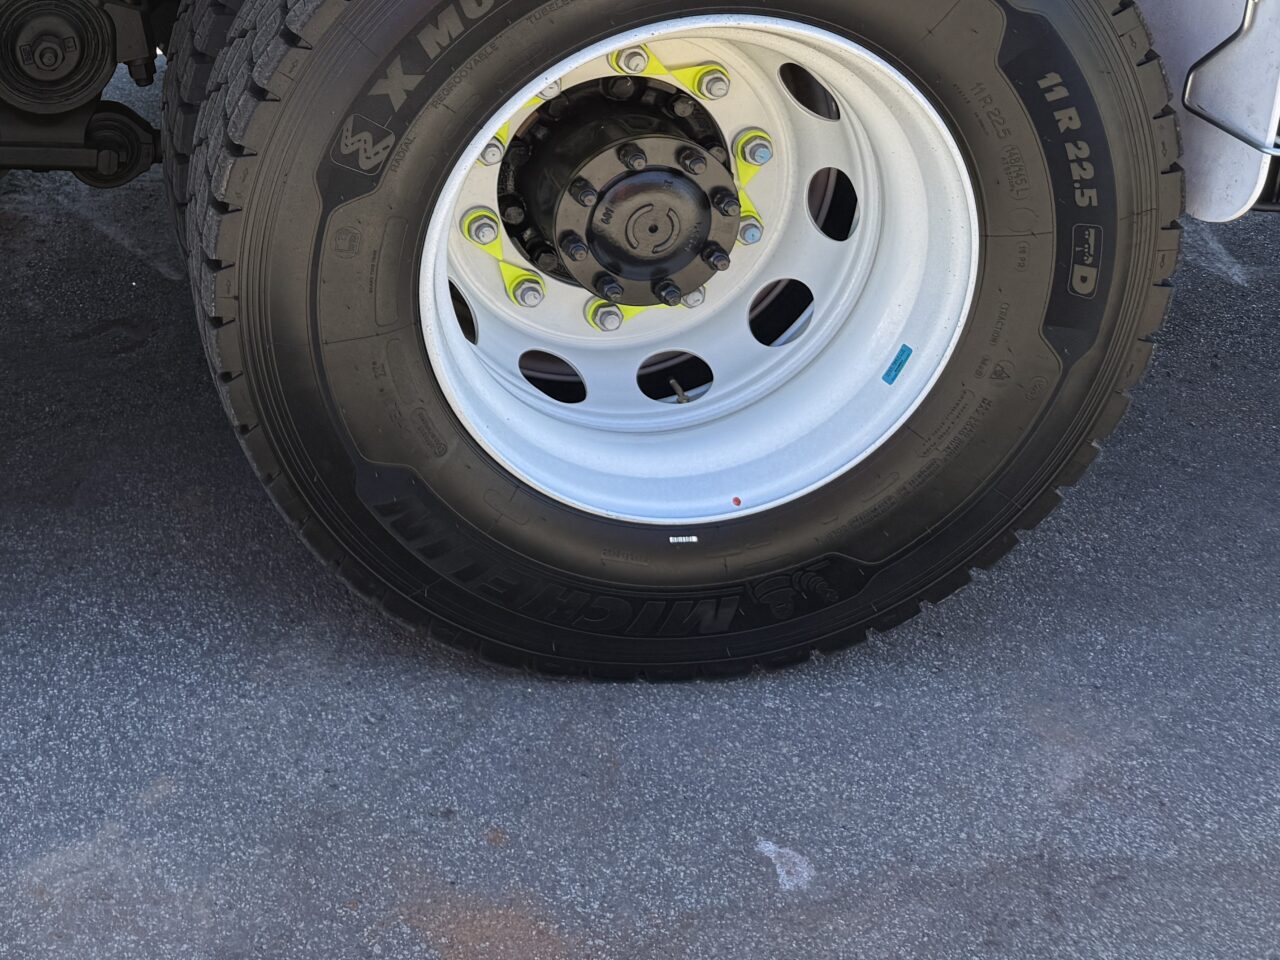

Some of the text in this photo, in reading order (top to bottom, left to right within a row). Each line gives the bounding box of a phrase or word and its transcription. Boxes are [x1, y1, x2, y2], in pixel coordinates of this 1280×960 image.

[367, 55, 426, 112] X
[1036, 71, 1098, 208] 11 R 22.5
[372, 500, 741, 635] MICHELIN
